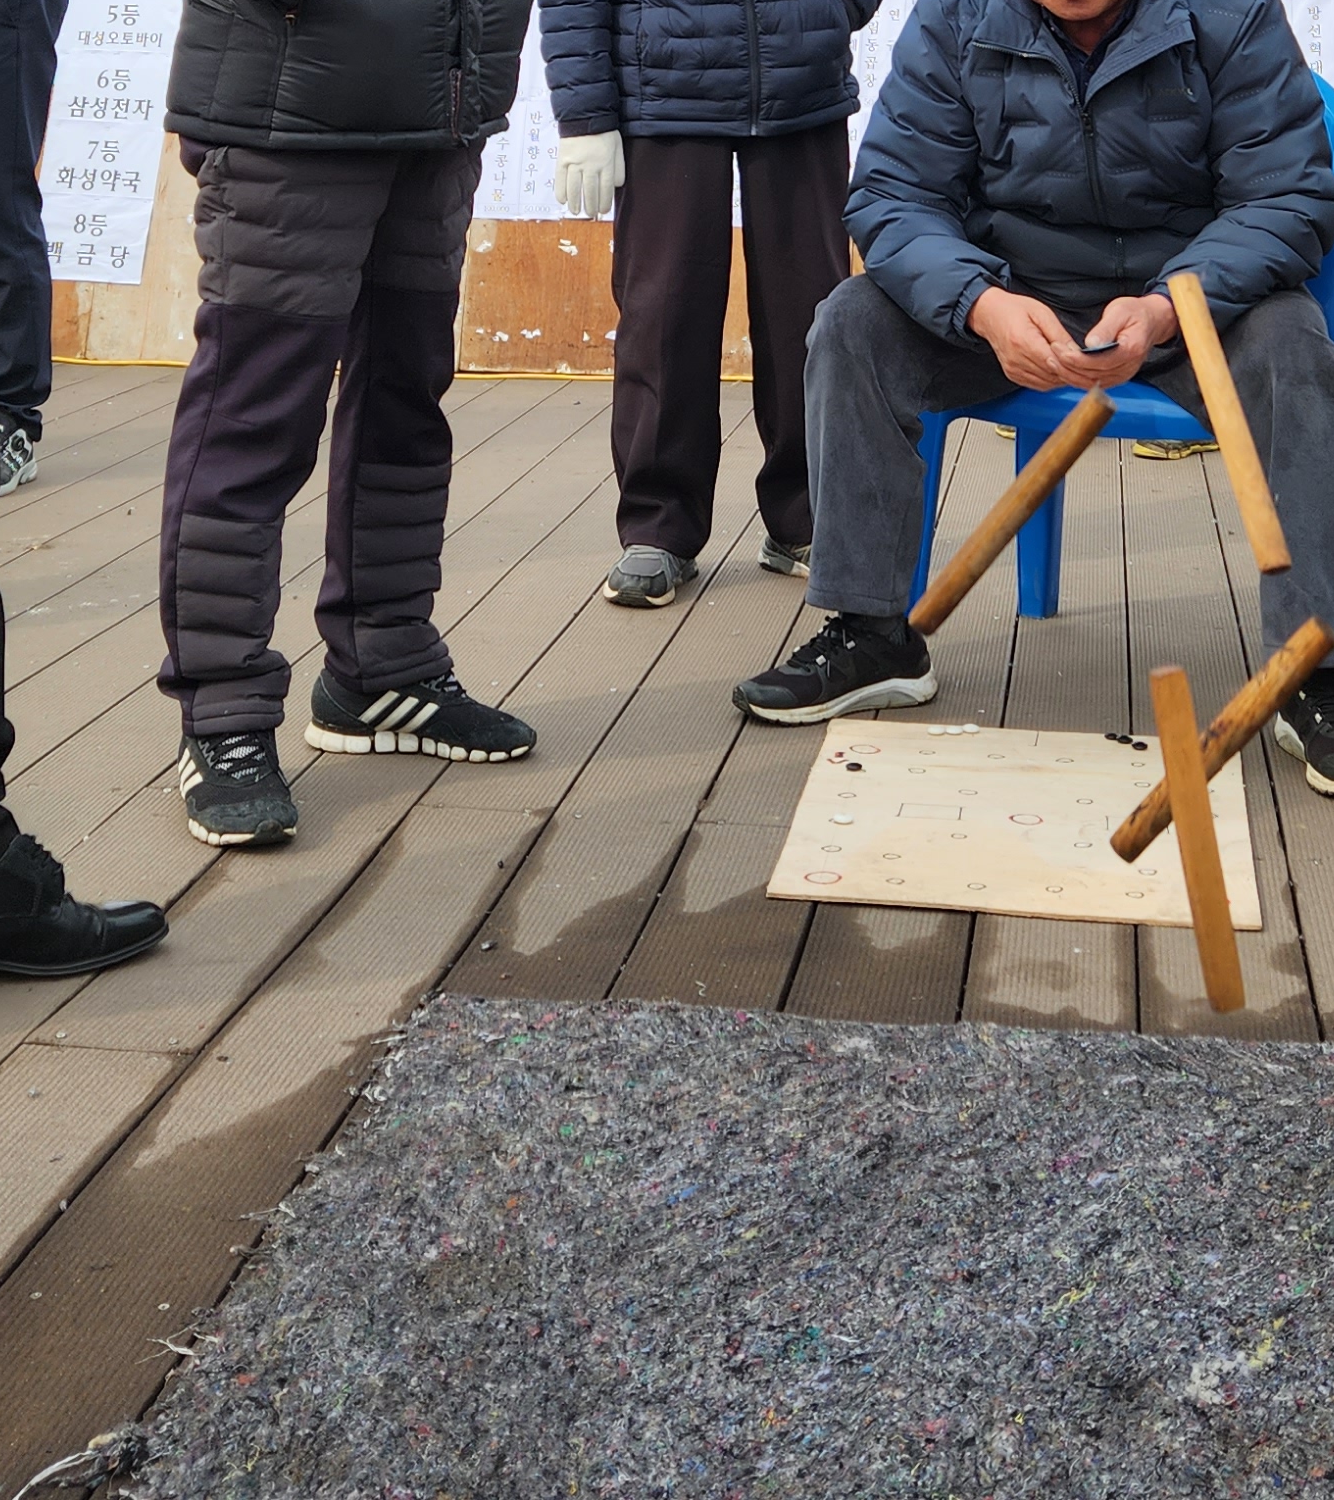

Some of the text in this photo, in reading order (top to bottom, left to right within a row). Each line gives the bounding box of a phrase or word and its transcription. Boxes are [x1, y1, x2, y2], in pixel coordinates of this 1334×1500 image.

[106, 3, 141, 27] 5등
[78, 30, 163, 48] 대성오토바이
[96, 68, 132, 92] 6등
[67, 95, 155, 121] 삼성전자
[87, 139, 121, 163] 7등
[55, 166, 142, 193] 화성약국
[73, 213, 108, 237] 8등
